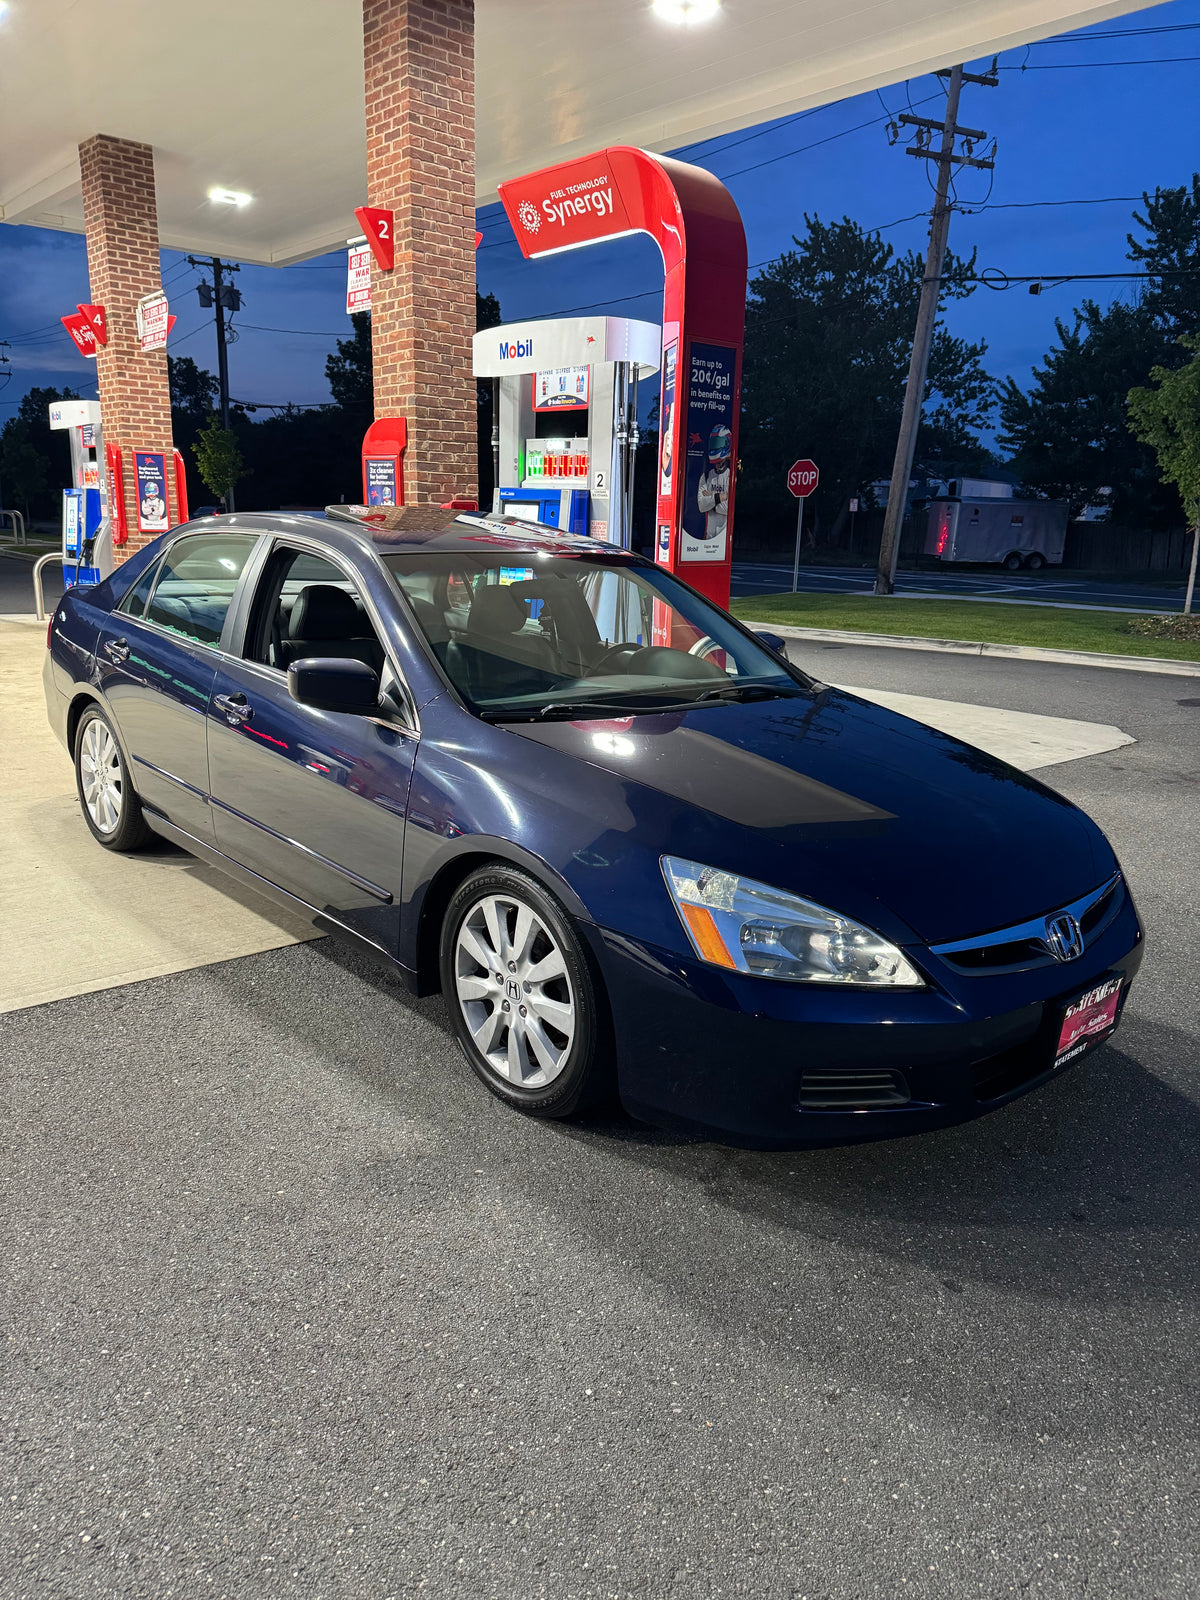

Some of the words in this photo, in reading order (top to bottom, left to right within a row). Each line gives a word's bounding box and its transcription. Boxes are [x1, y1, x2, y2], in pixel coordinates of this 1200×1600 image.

[549, 190, 566, 200] FUEL
[565, 175, 608, 196] TECHNOLOGY
[542, 187, 614, 227] Synergy
[378, 220, 390, 239] 2
[355, 267, 370, 278] WAR
[92, 313, 103, 326] 4
[499, 338, 533, 360] Mobil
[691, 357, 707, 366] Earn
[707, 361, 715, 370] up
[715, 360, 723, 369] to
[691, 368, 730, 389] 20¢/gal
[690, 387, 697, 397] in
[697, 388, 722, 400] benefits
[690, 401, 708, 411] every
[708, 400, 726, 413] fill-up
[369, 466, 376, 474] 3x
[376, 466, 394, 474] cleaner
[596, 473, 604, 488] 2
[789, 471, 817, 486] STOP
[711, 483, 725, 493] Mobil
[1053, 1041, 1088, 1070] STATEMENT
